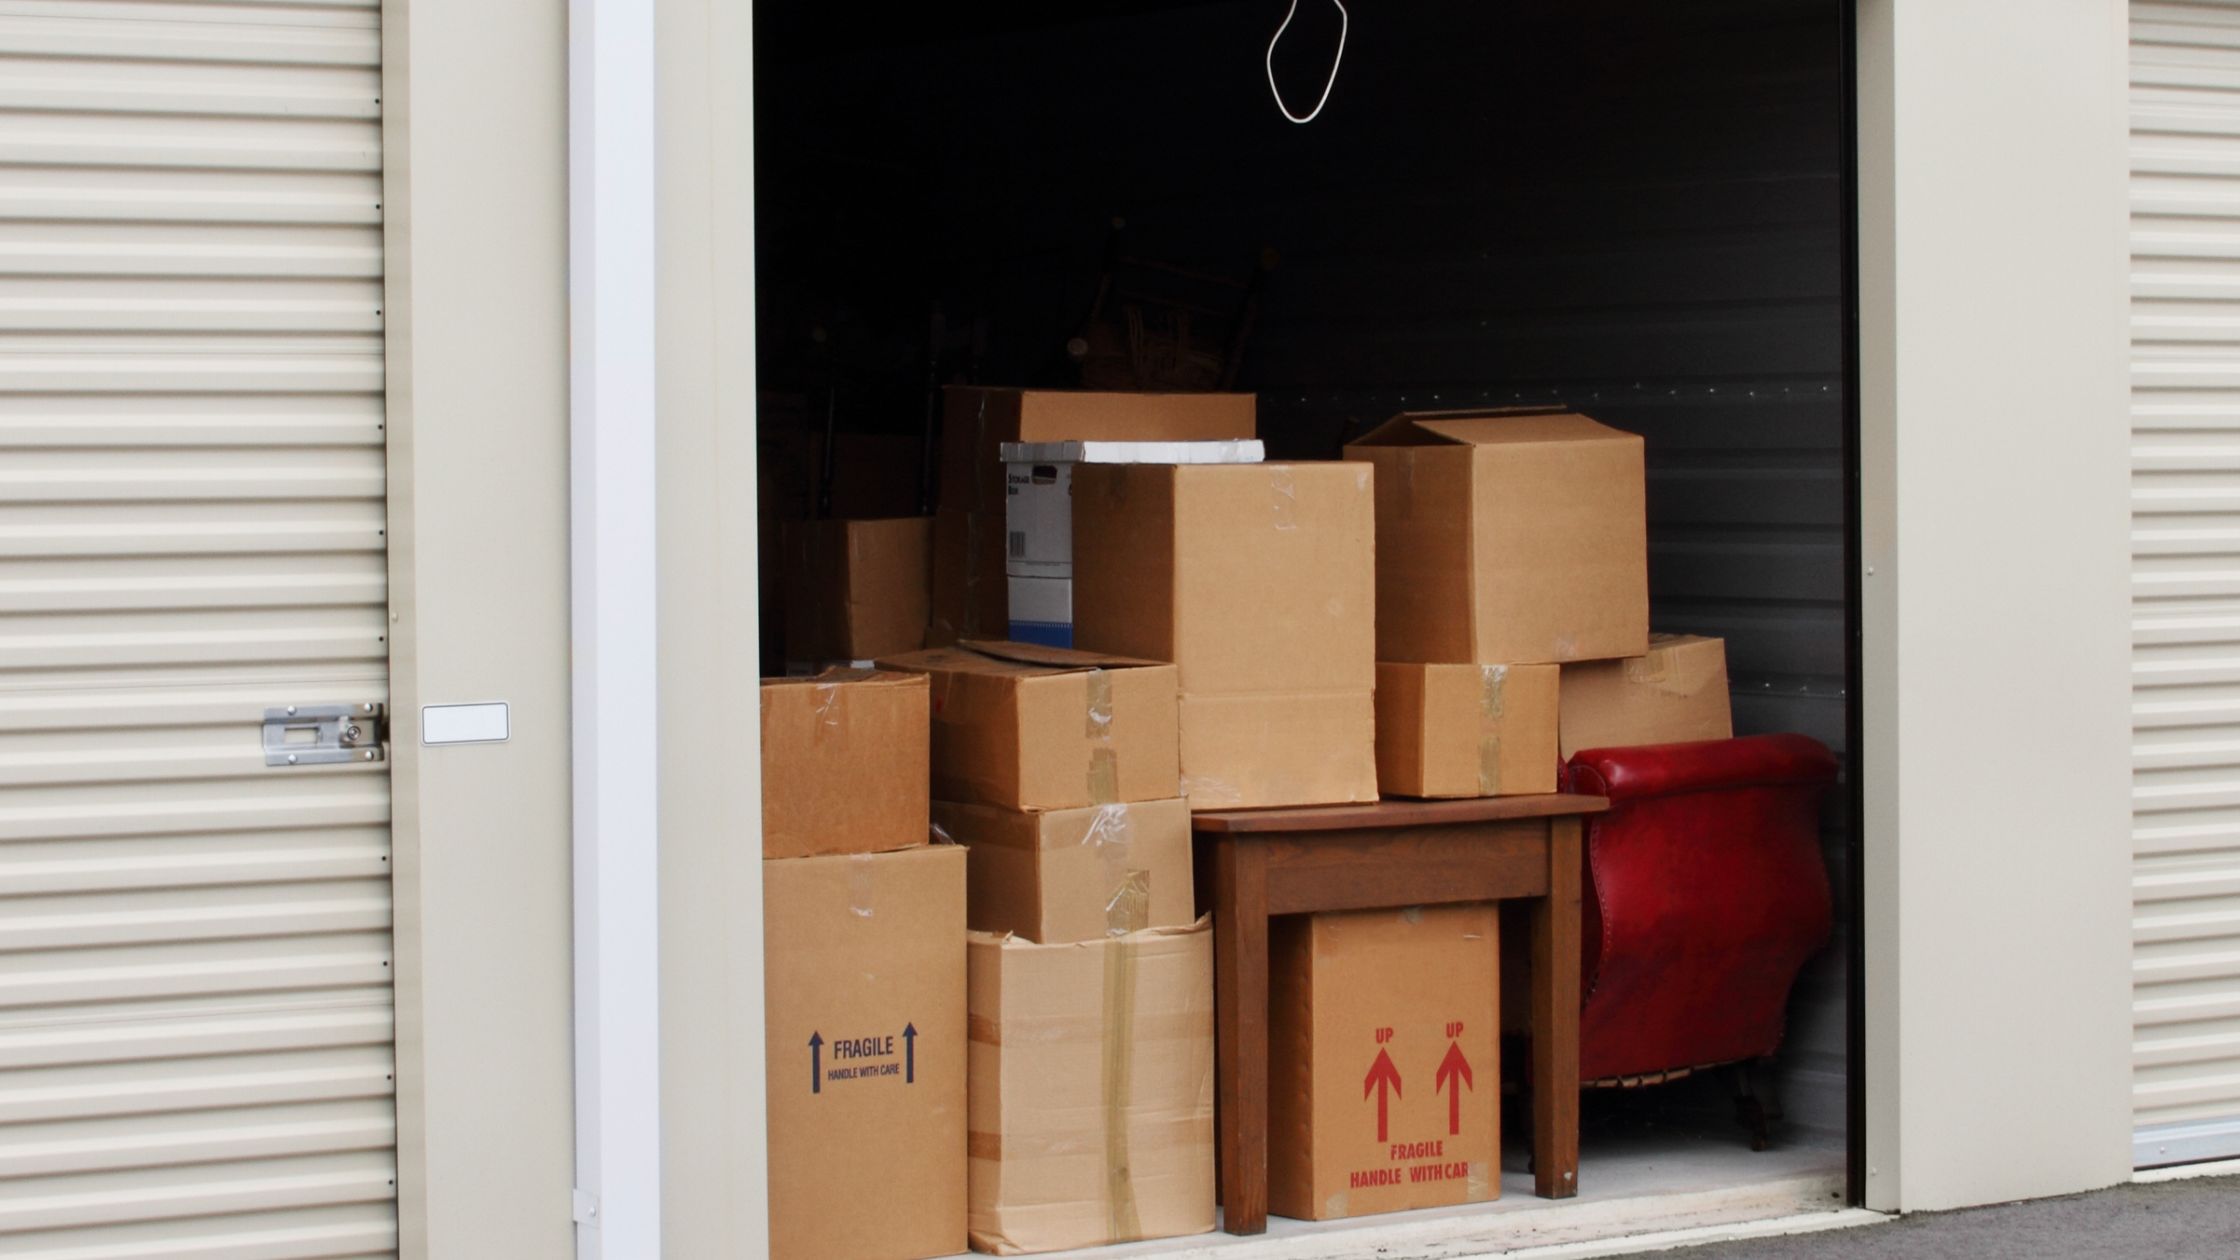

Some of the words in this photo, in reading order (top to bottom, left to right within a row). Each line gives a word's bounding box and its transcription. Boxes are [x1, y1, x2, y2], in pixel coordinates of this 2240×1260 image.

[1376, 1028, 1394, 1044] UP
[1446, 1022, 1464, 1038] UP
[834, 1036, 894, 1060] FRAGILE
[828, 1067, 858, 1080] HANDLE
[860, 1065, 879, 1077] WITH
[880, 1063, 900, 1075] CARE
[1390, 1140, 1443, 1161] FRAGILE
[1350, 1168, 1402, 1188] HANDLE
[1409, 1163, 1443, 1182] WITH
[1444, 1162, 1469, 1179] CAR
